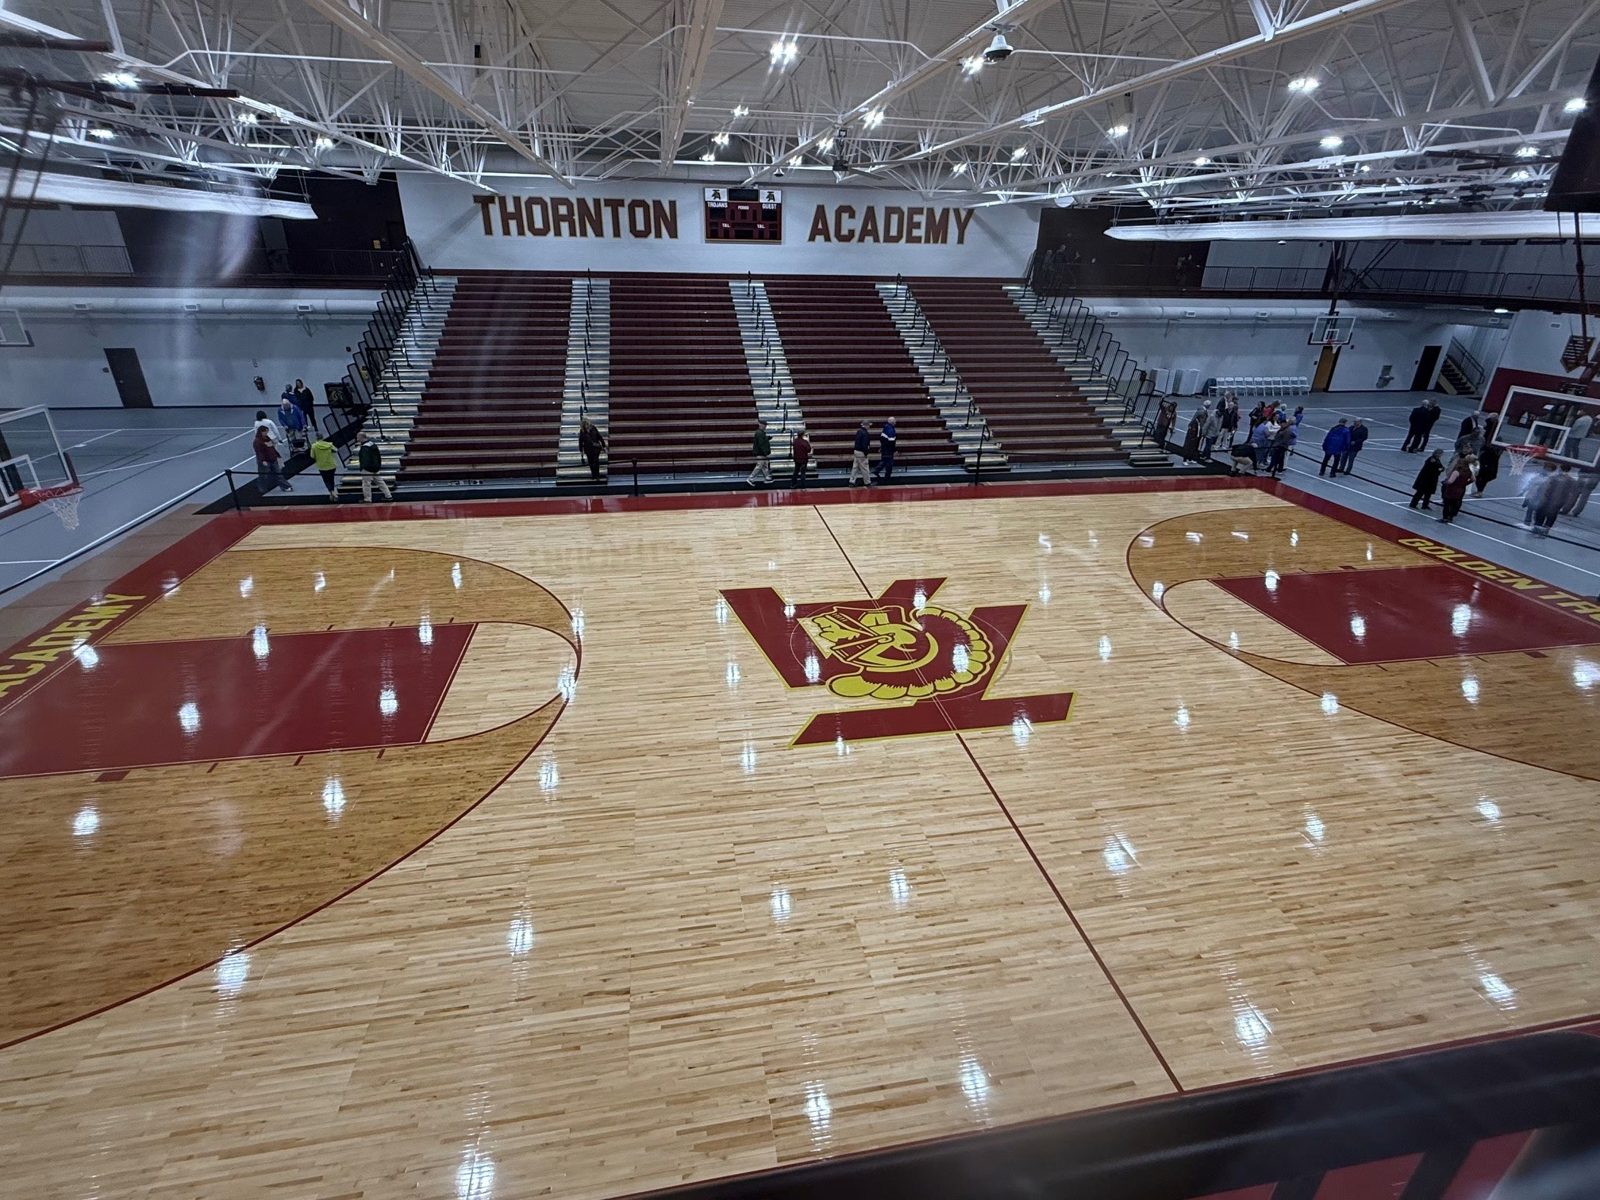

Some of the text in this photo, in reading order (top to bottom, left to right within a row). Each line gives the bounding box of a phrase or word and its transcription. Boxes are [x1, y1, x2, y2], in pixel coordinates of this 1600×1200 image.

[472, 194, 976, 245] THORNTON ACADEMY
[1397, 538, 1549, 590] GOLDEN
